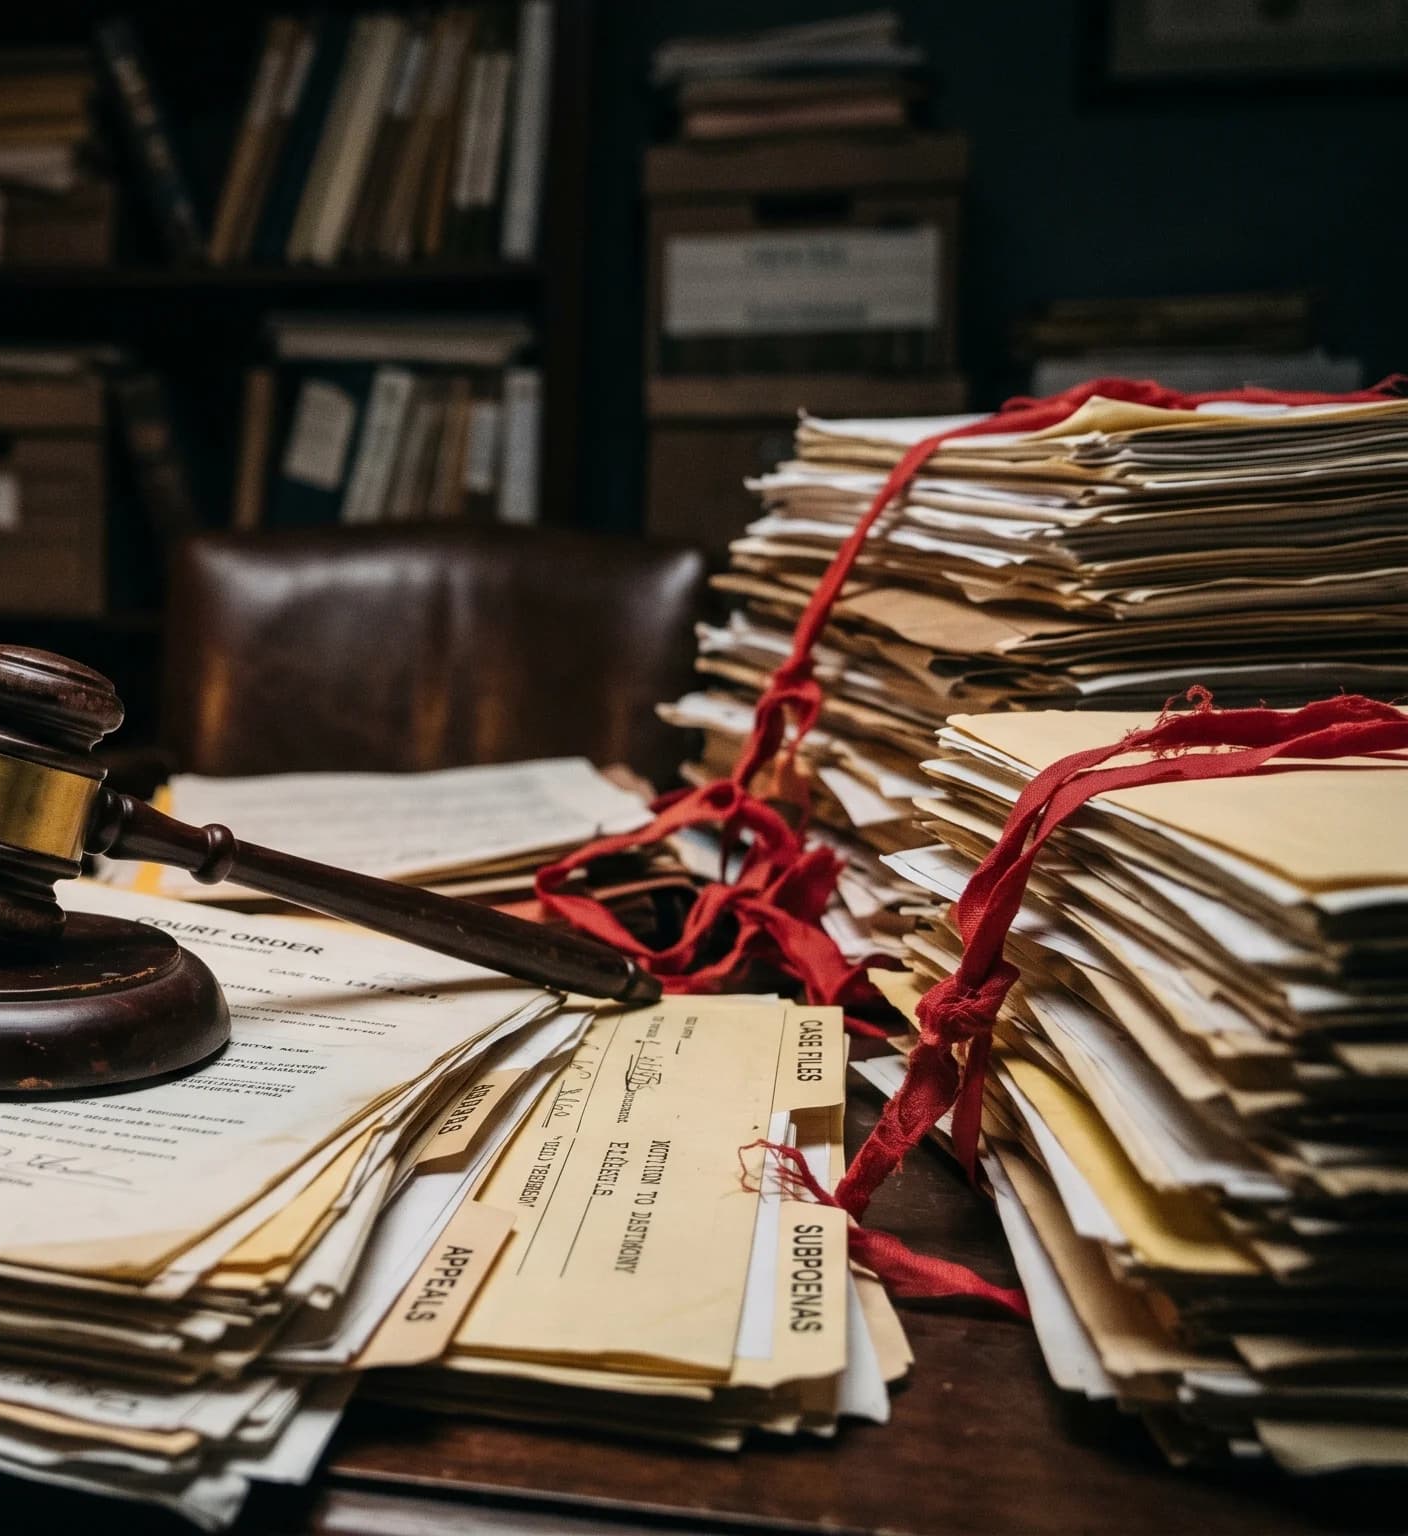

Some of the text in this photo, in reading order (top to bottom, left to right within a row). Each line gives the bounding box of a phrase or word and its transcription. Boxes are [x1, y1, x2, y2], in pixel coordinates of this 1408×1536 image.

[136, 916, 228, 937] COURT
[230, 932, 324, 955] ORDER
[797, 1020, 823, 1082] CASE FILES
[634, 1191, 658, 1206] TO
[404, 1245, 473, 1322] APPEALS
[790, 1224, 824, 1333] SUBPOENAS
